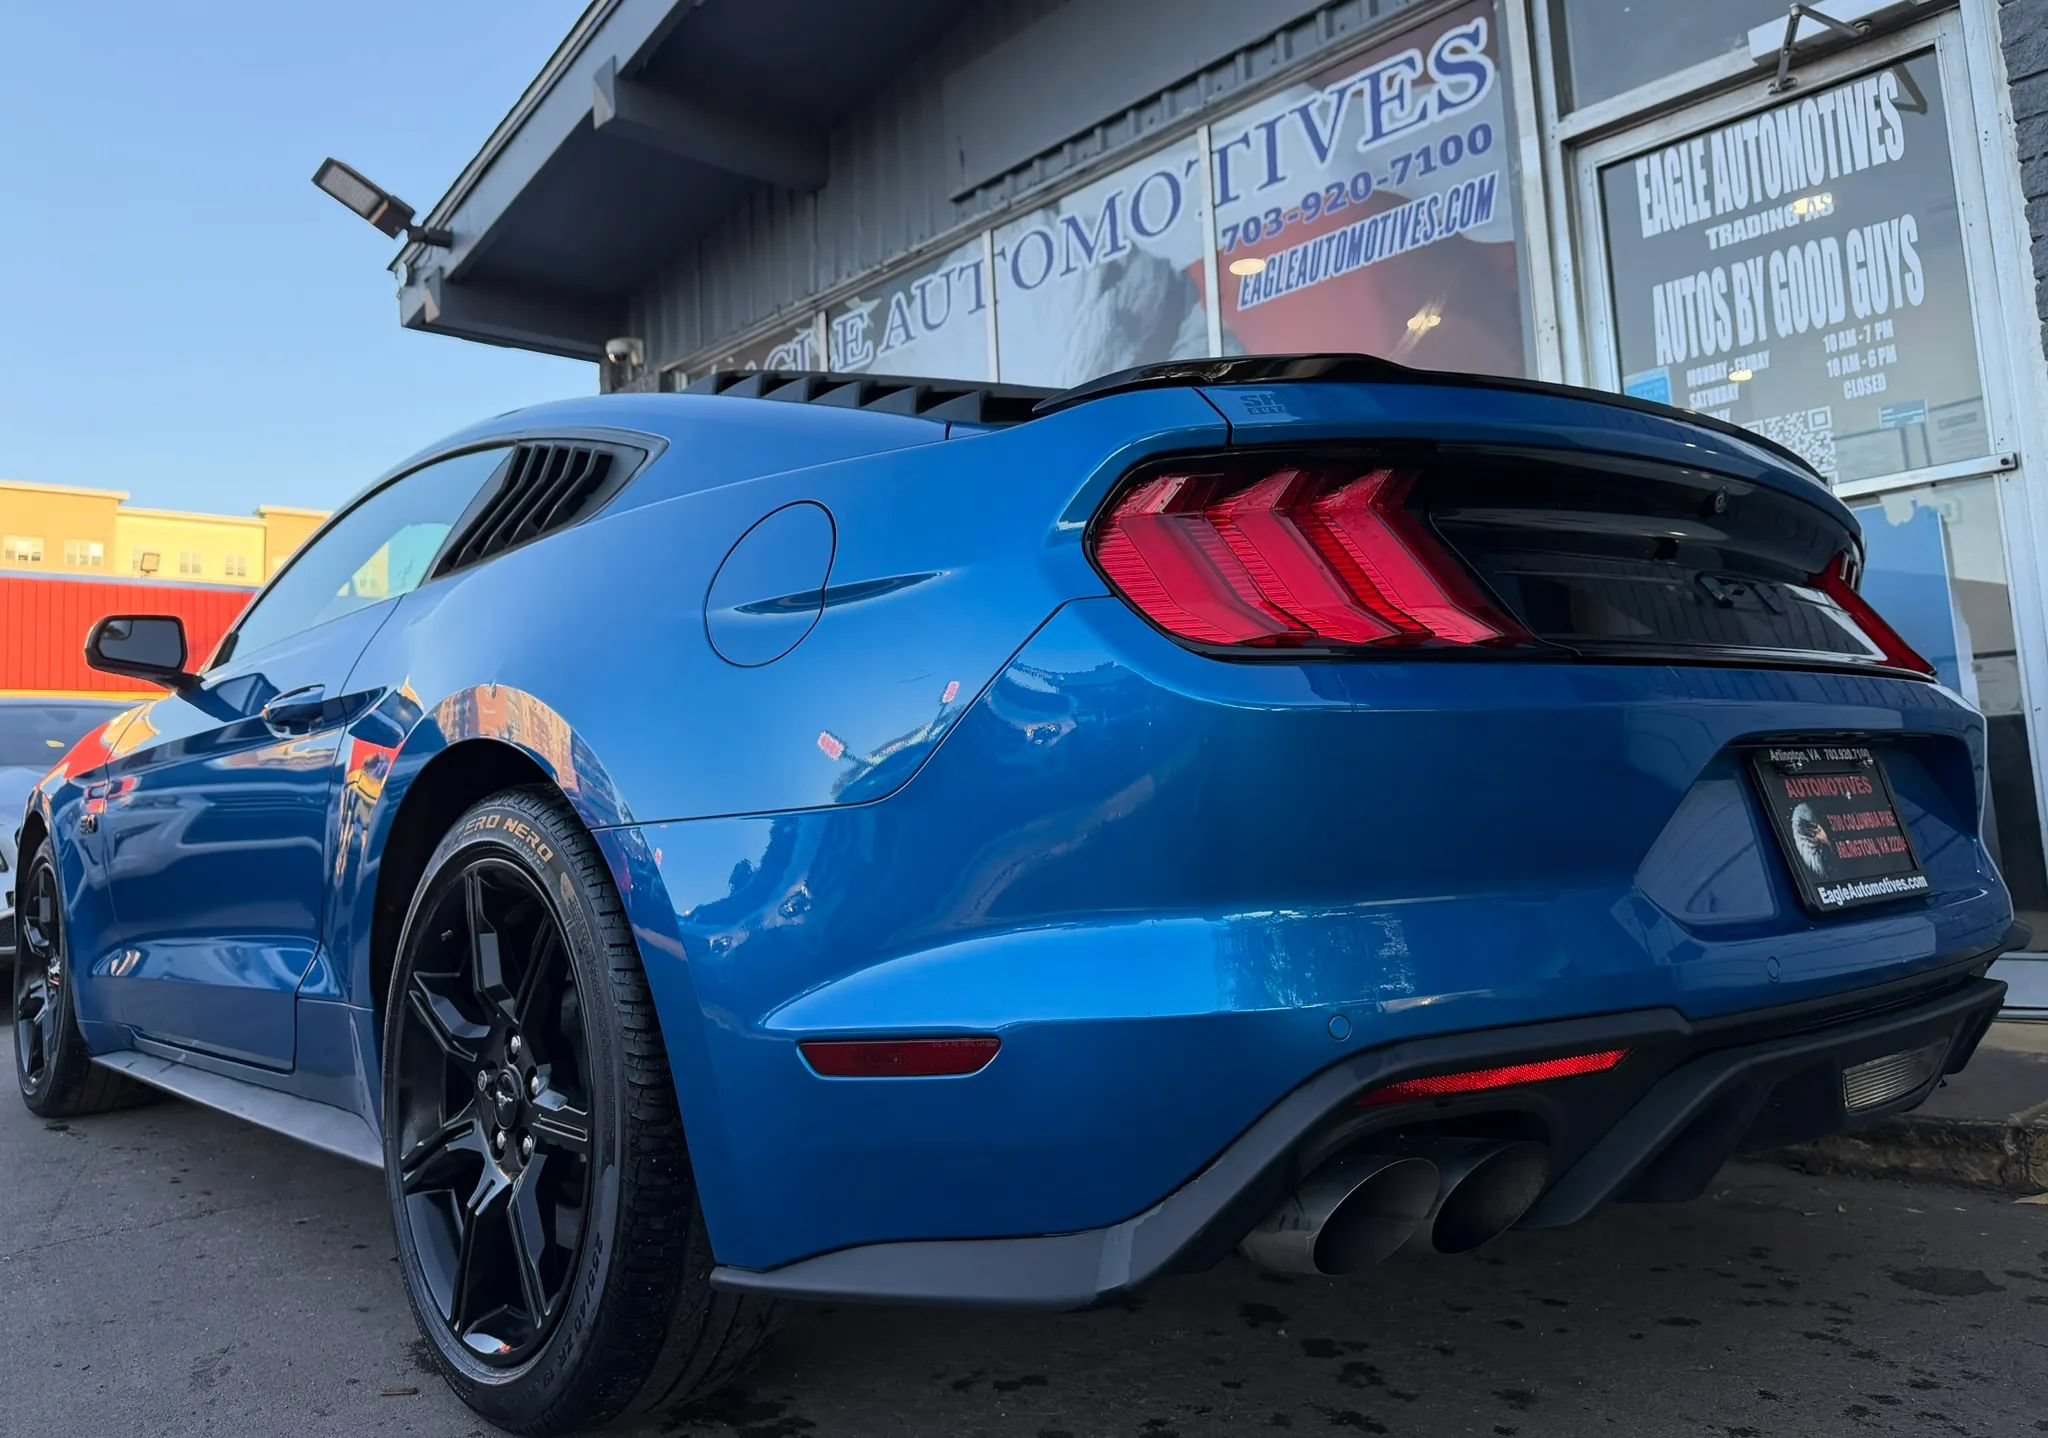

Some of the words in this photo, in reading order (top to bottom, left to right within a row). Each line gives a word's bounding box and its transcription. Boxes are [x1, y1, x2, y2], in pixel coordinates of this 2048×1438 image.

[1635, 138, 1711, 239] EAGLE
[1711, 71, 1904, 214] AUTOMOTIVES
[878, 20, 1490, 354] AUTOMOTIVES
[1222, 123, 1493, 252] 703-920-7100
[1238, 172, 1498, 309] EAGLEAUTOMOTIVES.COM
[1705, 203, 1795, 250] TRADING
[1803, 193, 1835, 222] AS
[1652, 265, 1732, 366] AUTOS
[1731, 255, 1767, 347] BY
[1769, 236, 1846, 339] GOOD
[1846, 213, 1925, 320] GUYS
[1822, 333, 1838, 355] 10
[1874, 318, 1894, 341] PM
[1826, 357, 1841, 379] 10
[1867, 348, 1877, 369] 6
[1877, 343, 1897, 367] PM
[1843, 373, 1888, 400] CLOSED
[1807, 749, 1822, 761] VA
[1784, 775, 1873, 799] AUTOMOTIVES
[502, 817, 554, 863] NERO
[1817, 875, 1929, 906] EagleAutomotives.com
